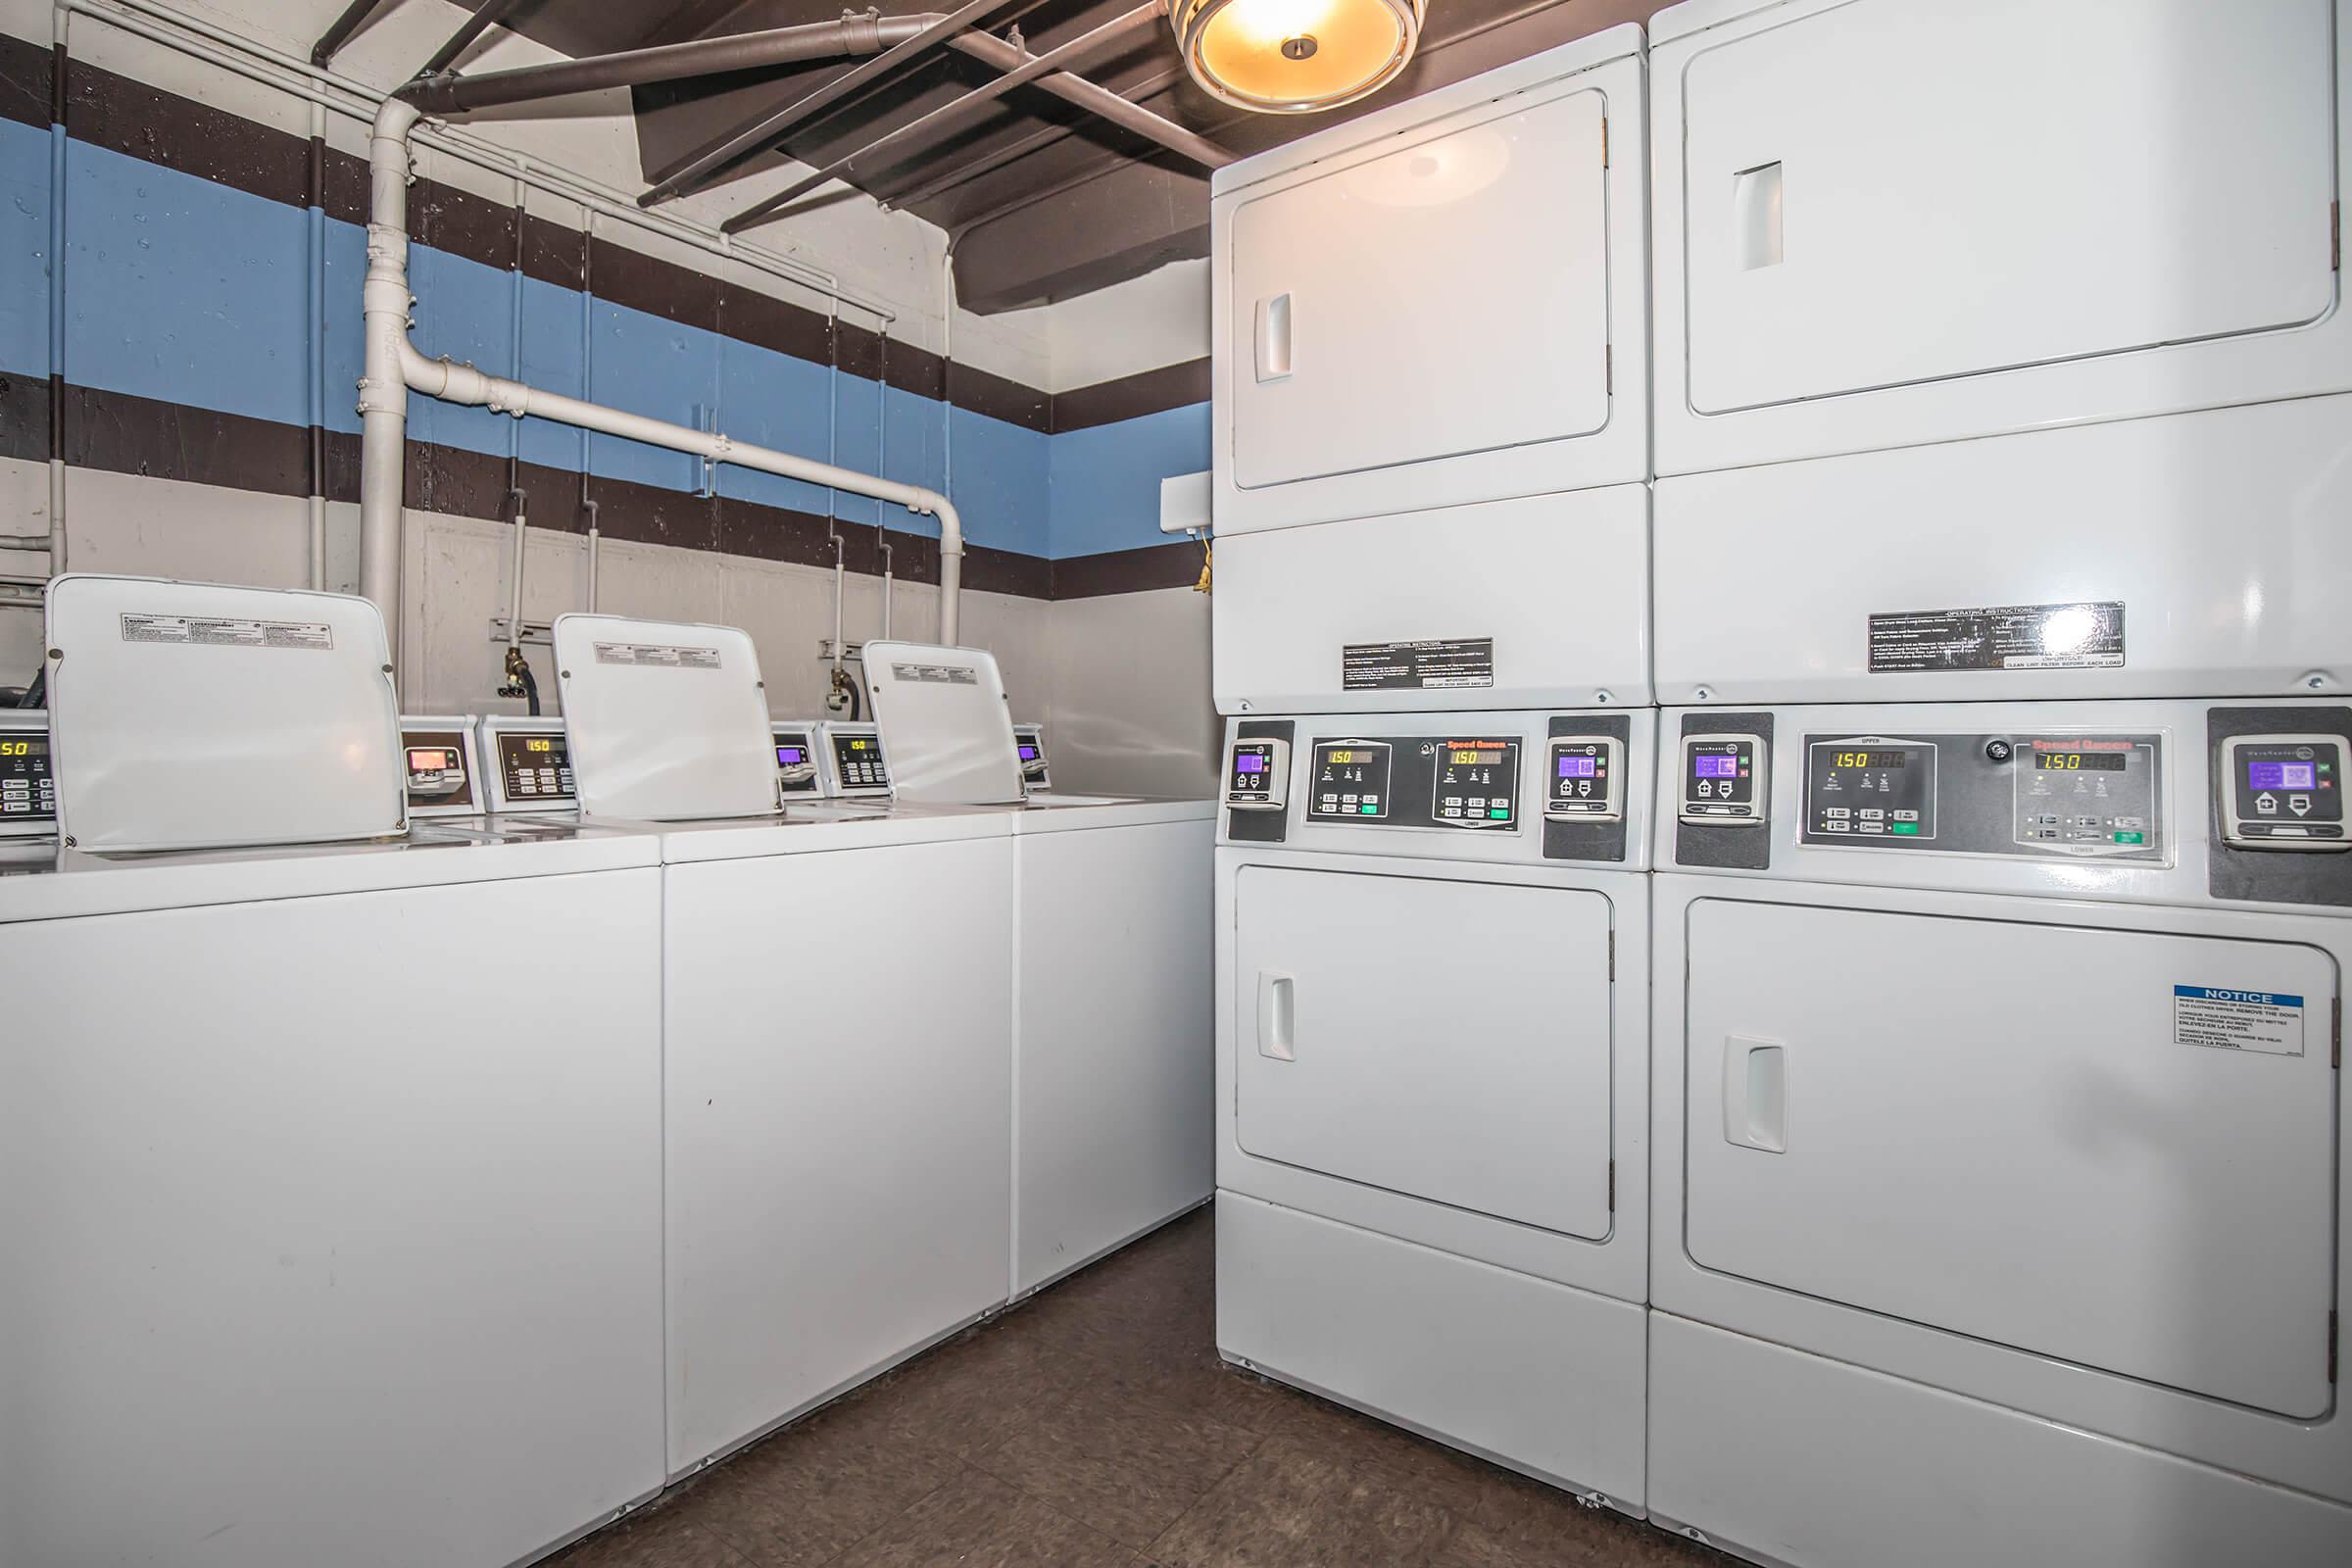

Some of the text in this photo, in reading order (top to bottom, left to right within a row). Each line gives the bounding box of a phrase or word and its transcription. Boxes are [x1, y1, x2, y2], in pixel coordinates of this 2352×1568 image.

[1447, 740, 1506, 750] Speed Queen
[2032, 740, 2132, 751] Speed Queen
[1838, 753, 1868, 767] 1.50
[2205, 989, 2274, 1004] NOTICE
